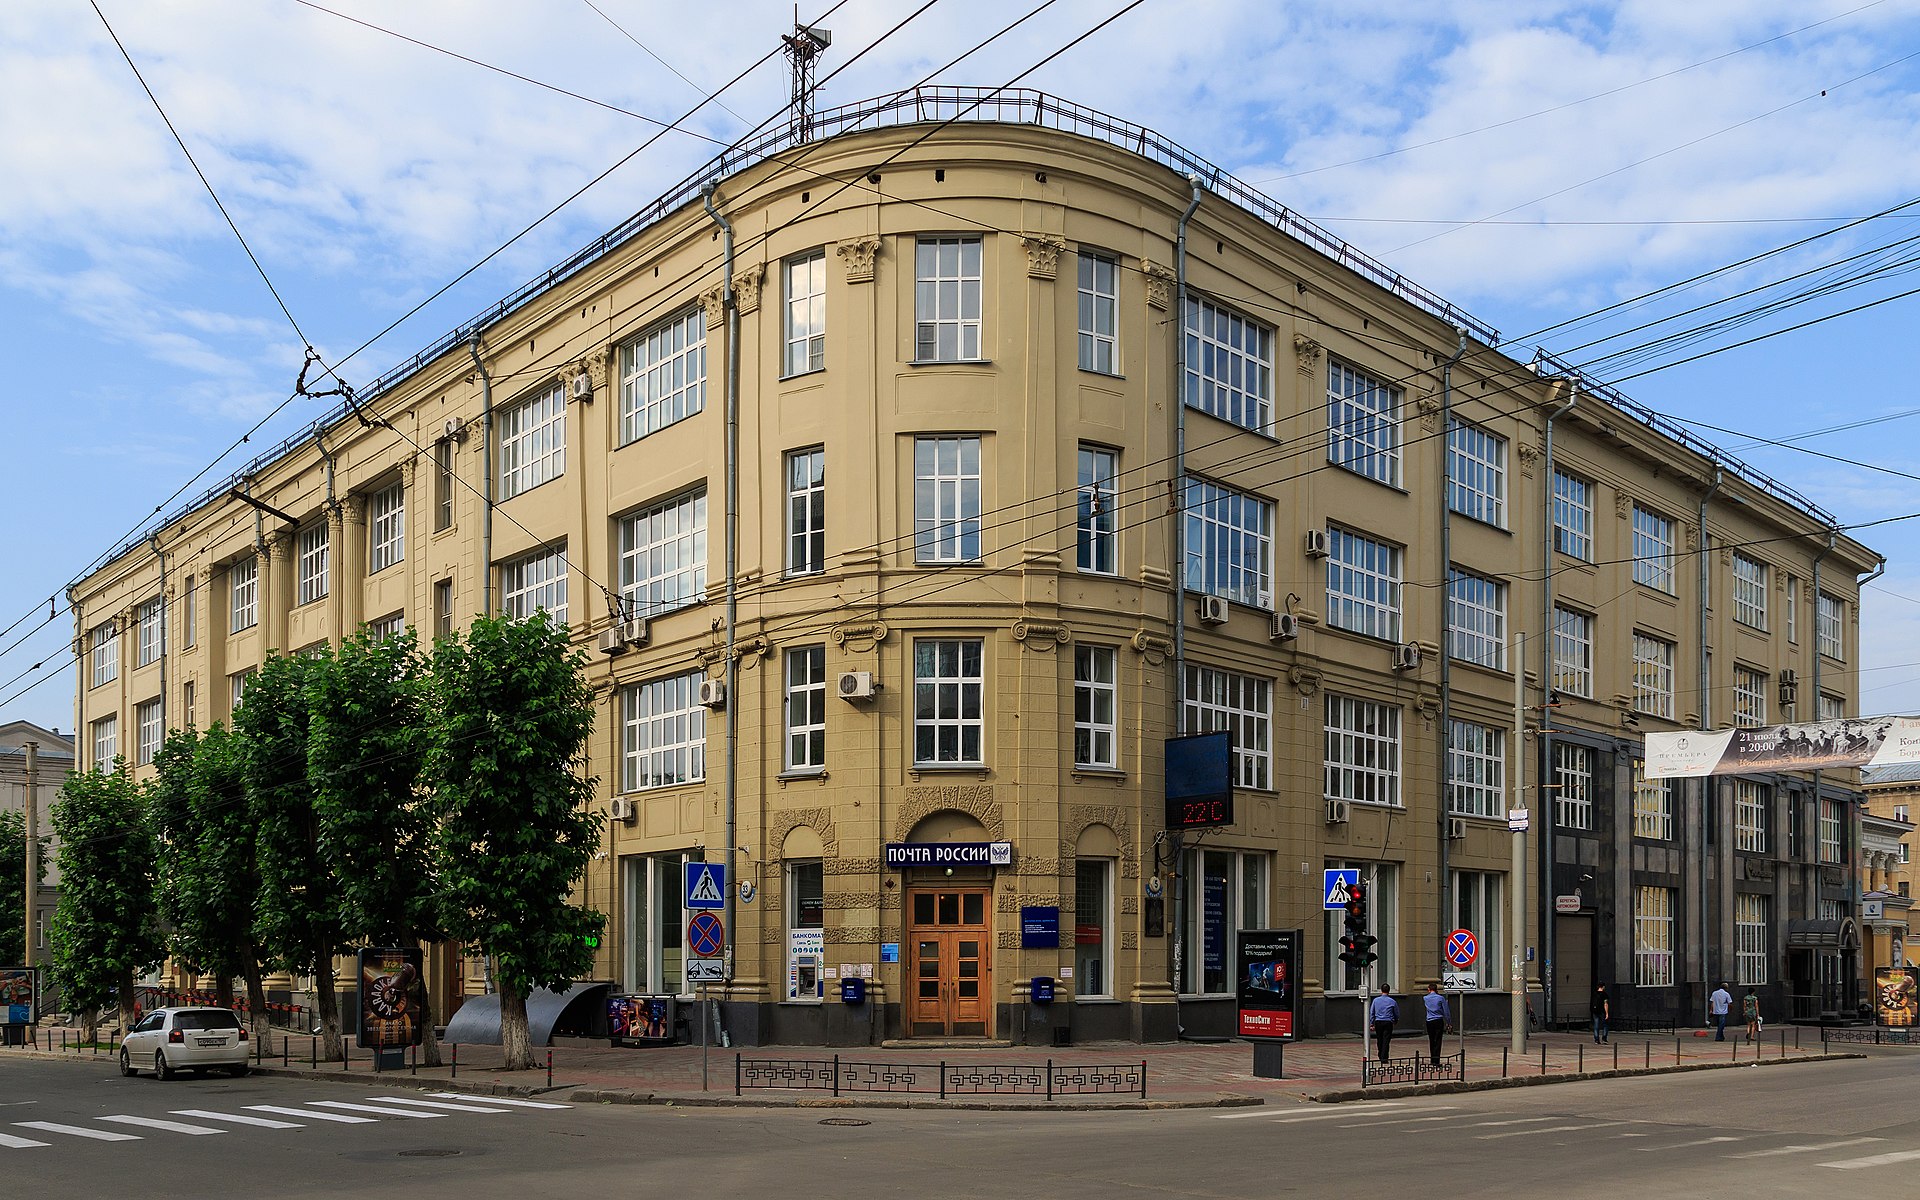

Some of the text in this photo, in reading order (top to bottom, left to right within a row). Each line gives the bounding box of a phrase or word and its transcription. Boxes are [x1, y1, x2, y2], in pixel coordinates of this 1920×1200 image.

[1739, 733, 1781, 742] 21 июля
[1748, 742, 1775, 752] 20:00
[888, 847, 989, 862] ПОЧТА РОССИИ
[742, 884, 750, 893] 33
[1154, 879, 1159, 889] 5
[371, 978, 392, 1016] KARAOKE
[1243, 1014, 1271, 1025] ТехноСити
